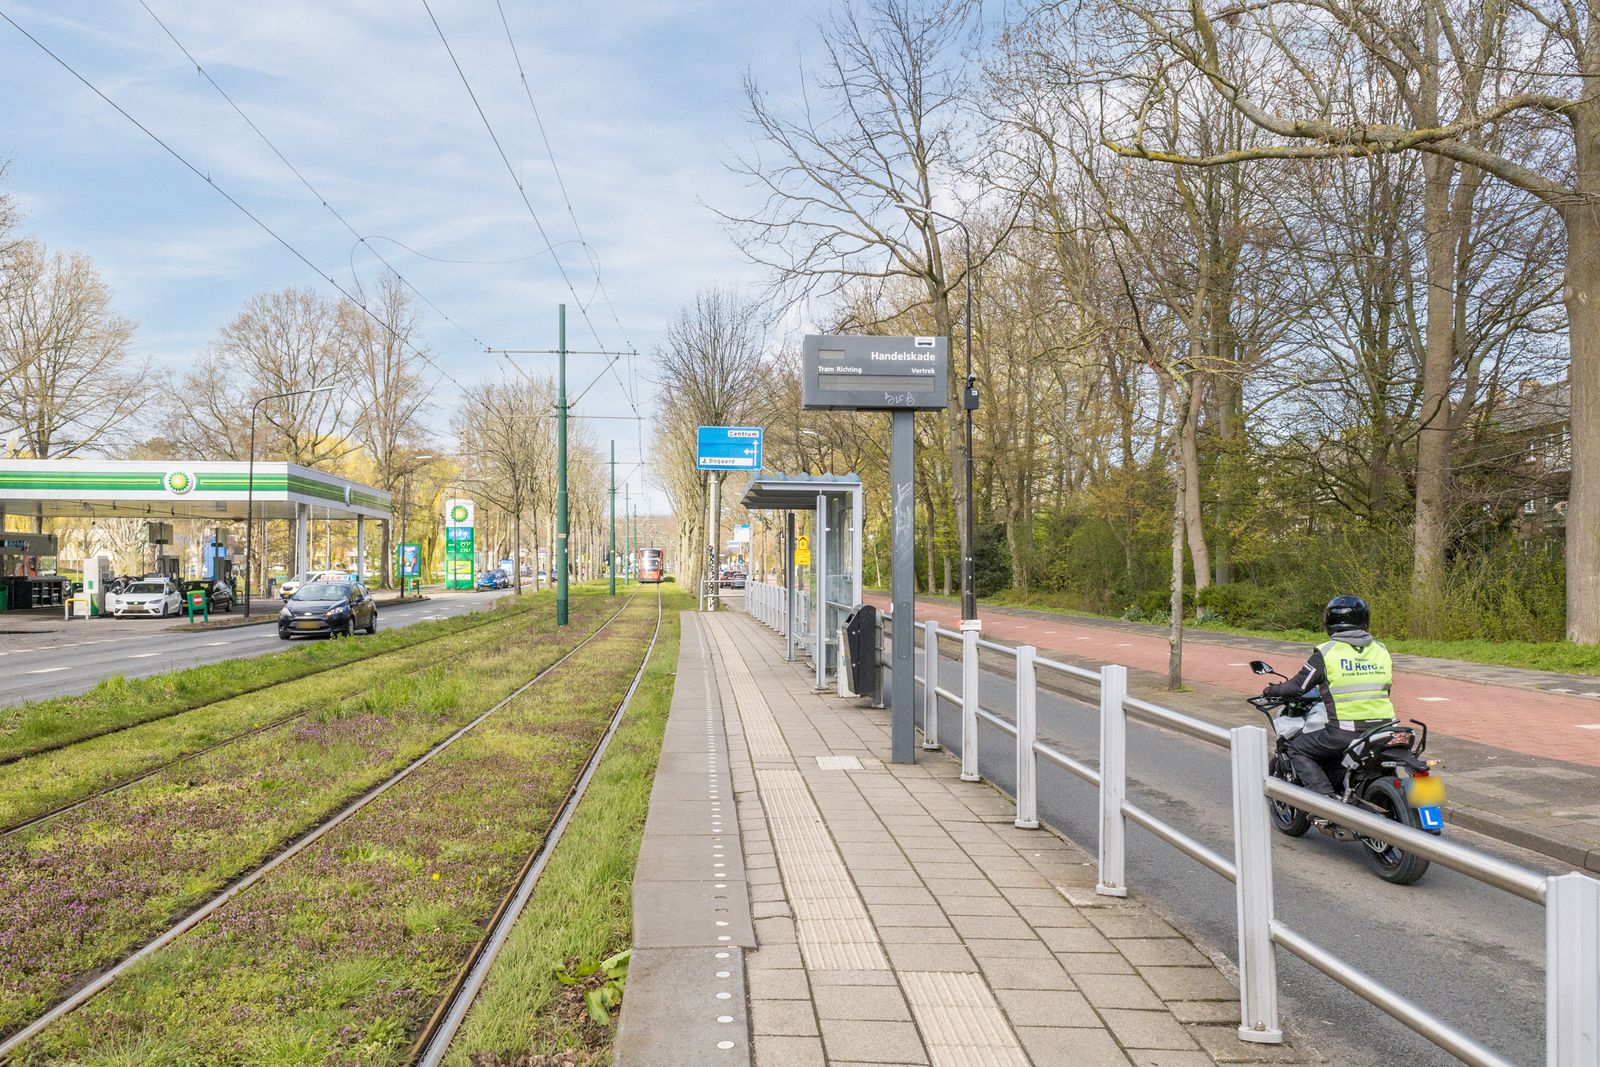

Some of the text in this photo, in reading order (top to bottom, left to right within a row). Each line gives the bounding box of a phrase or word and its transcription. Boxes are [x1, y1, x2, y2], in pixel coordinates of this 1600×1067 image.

[871, 352, 936, 361] Handelskade
[836, 366, 862, 374] Richting
[1355, 662, 1377, 671] Hero
[1424, 810, 1438, 825] L
